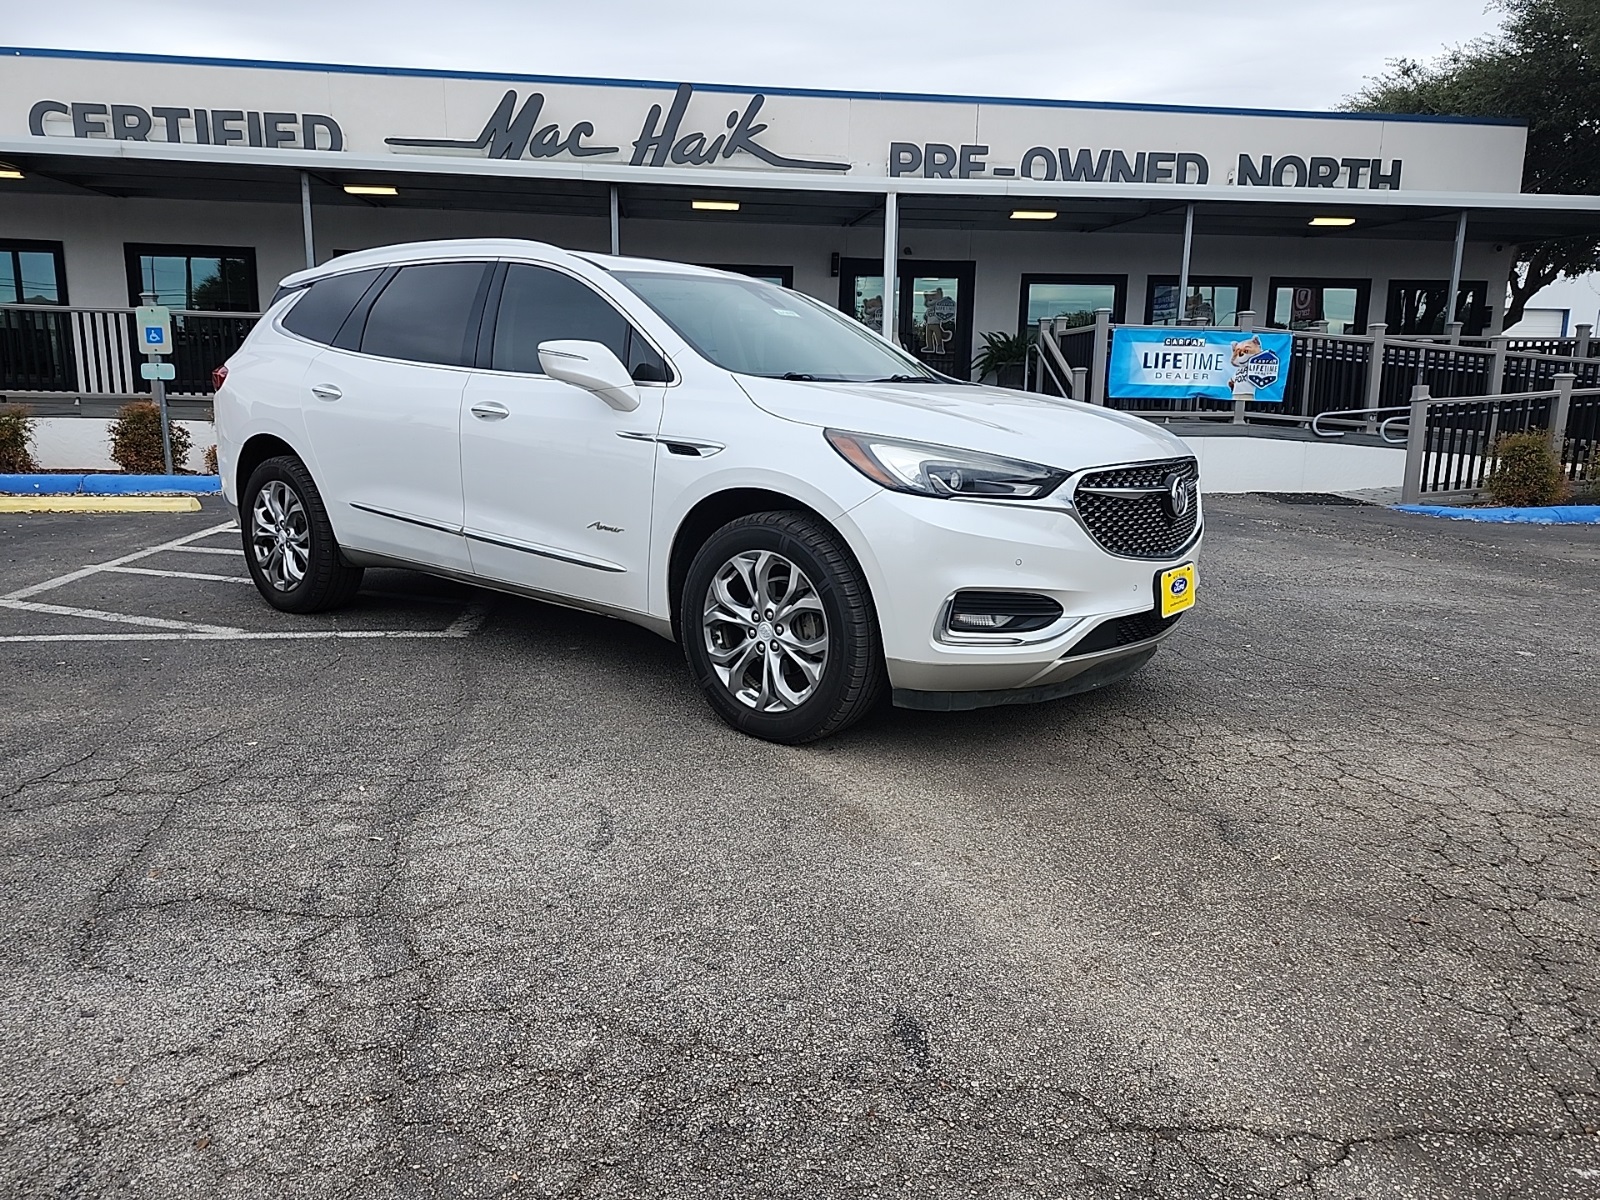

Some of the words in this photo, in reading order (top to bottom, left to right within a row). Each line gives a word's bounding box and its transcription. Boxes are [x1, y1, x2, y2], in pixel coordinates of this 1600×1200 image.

[28, 100, 344, 152] CERTIFIED
[384, 90, 619, 160] Mac
[629, 83, 852, 171] Haik
[889, 142, 1210, 185] PRE-OWNED
[1237, 153, 1402, 190] NORTH
[1164, 337, 1206, 347] CARFAX
[1142, 352, 1224, 371] LIFETIME
[1249, 364, 1278, 372] LIFETIME
[1155, 372, 1210, 380] DEALER
[1173, 579, 1186, 592] Ford
